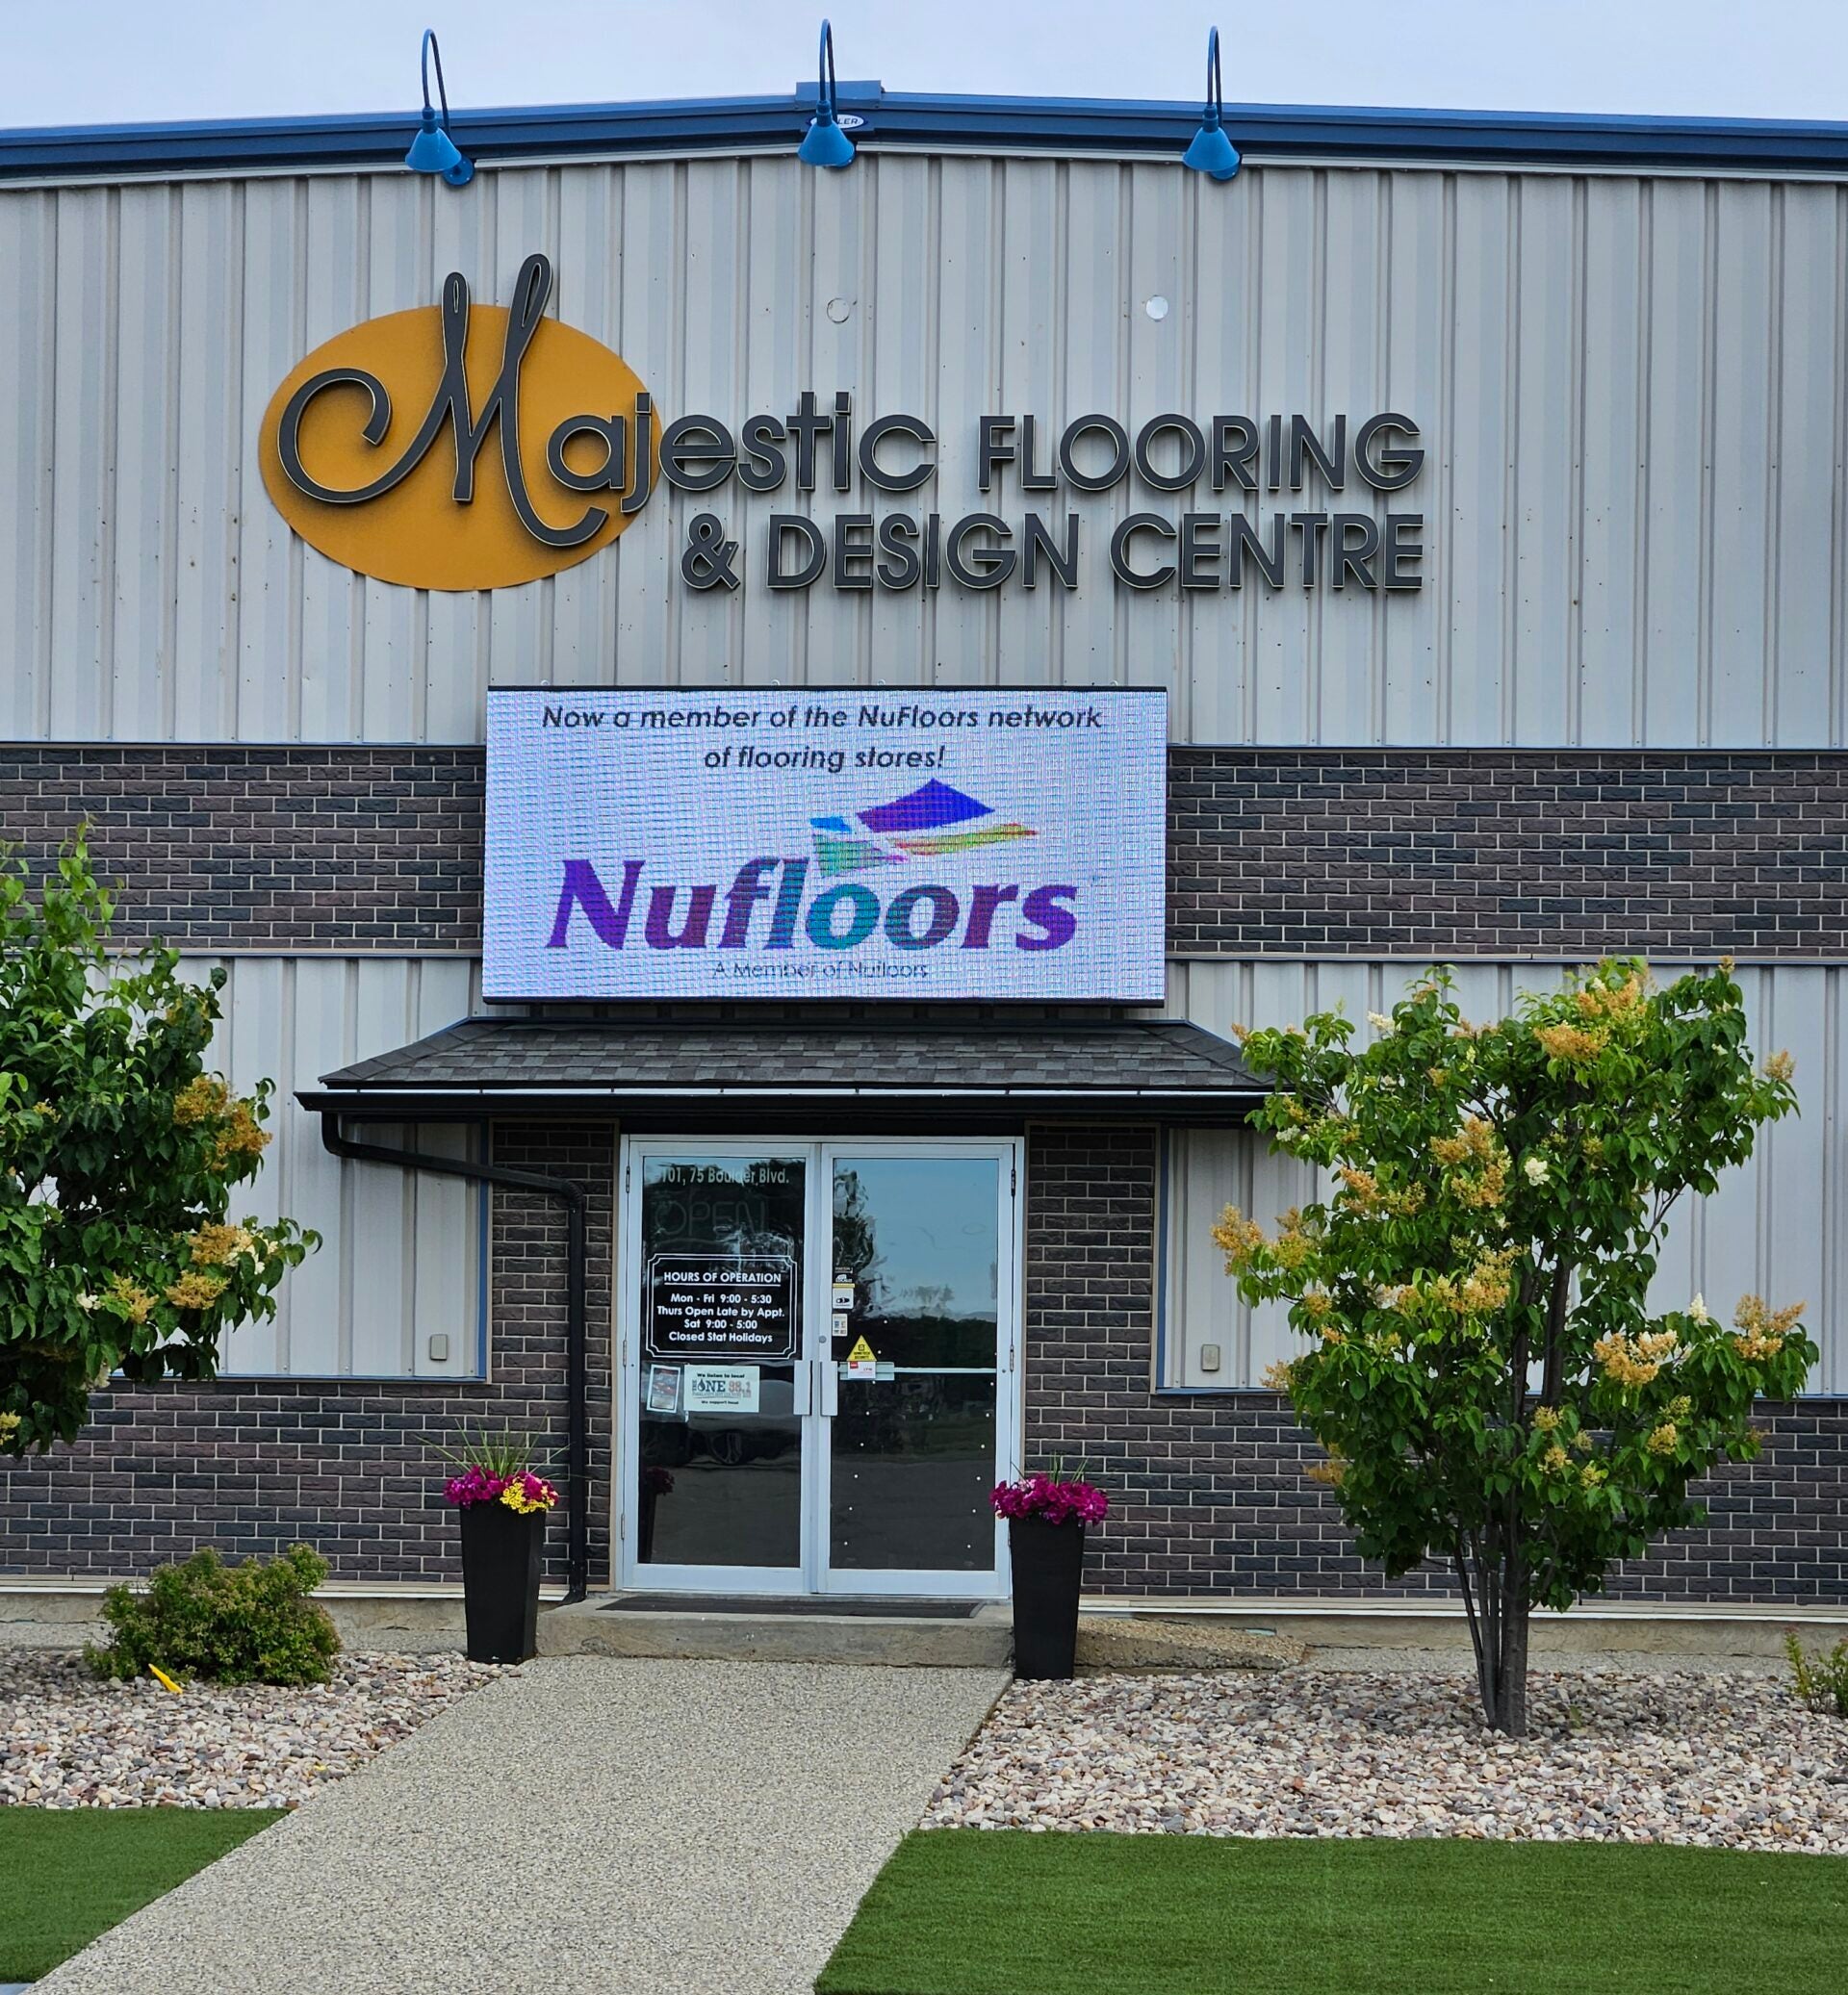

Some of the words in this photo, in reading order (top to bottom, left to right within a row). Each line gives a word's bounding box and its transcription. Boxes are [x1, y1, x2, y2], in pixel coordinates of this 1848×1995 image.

[277, 253, 937, 547] Majestic
[978, 412, 1426, 492] FLOORING
[680, 512, 741, 590] &
[766, 512, 1081, 590] DESIGN
[1110, 512, 1425, 590] CENTRE
[542, 705, 603, 729] Now
[613, 710, 630, 729] a
[640, 705, 760, 729] member
[770, 705, 797, 729] of
[804, 705, 847, 729] the
[858, 704, 979, 729] NuFloors
[988, 706, 1103, 729] network
[705, 746, 732, 769] of
[737, 746, 845, 774] flooring
[855, 745, 945, 769] stores!
[545, 856, 1078, 952] Nufloors
[713, 961, 727, 978] A
[733, 962, 818, 978] Member
[823, 961, 843, 978] of
[690, 1167, 705, 1184] 75
[758, 1167, 790, 1184] Blvd.
[654, 1200, 766, 1238] OPEN
[664, 1272, 700, 1283] HOURS
[703, 1272, 717, 1283] OF
[720, 1272, 782, 1284] OPERATION
[670, 1293, 693, 1303] Mon
[703, 1294, 715, 1303] Fri
[720, 1294, 741, 1304] 9:00
[751, 1294, 772, 1304] 5:30
[657, 1305, 682, 1316] Thurs
[684, 1306, 714, 1317] Open
[716, 1307, 739, 1317] Late
[741, 1307, 755, 1318] by
[757, 1307, 785, 1318] Appt.
[684, 1318, 701, 1328] Sat
[706, 1319, 727, 1329] 9:00
[736, 1319, 757, 1329] 5:00
[669, 1331, 705, 1342] Closed
[707, 1332, 727, 1342] Stat
[729, 1332, 773, 1344] Holidays
